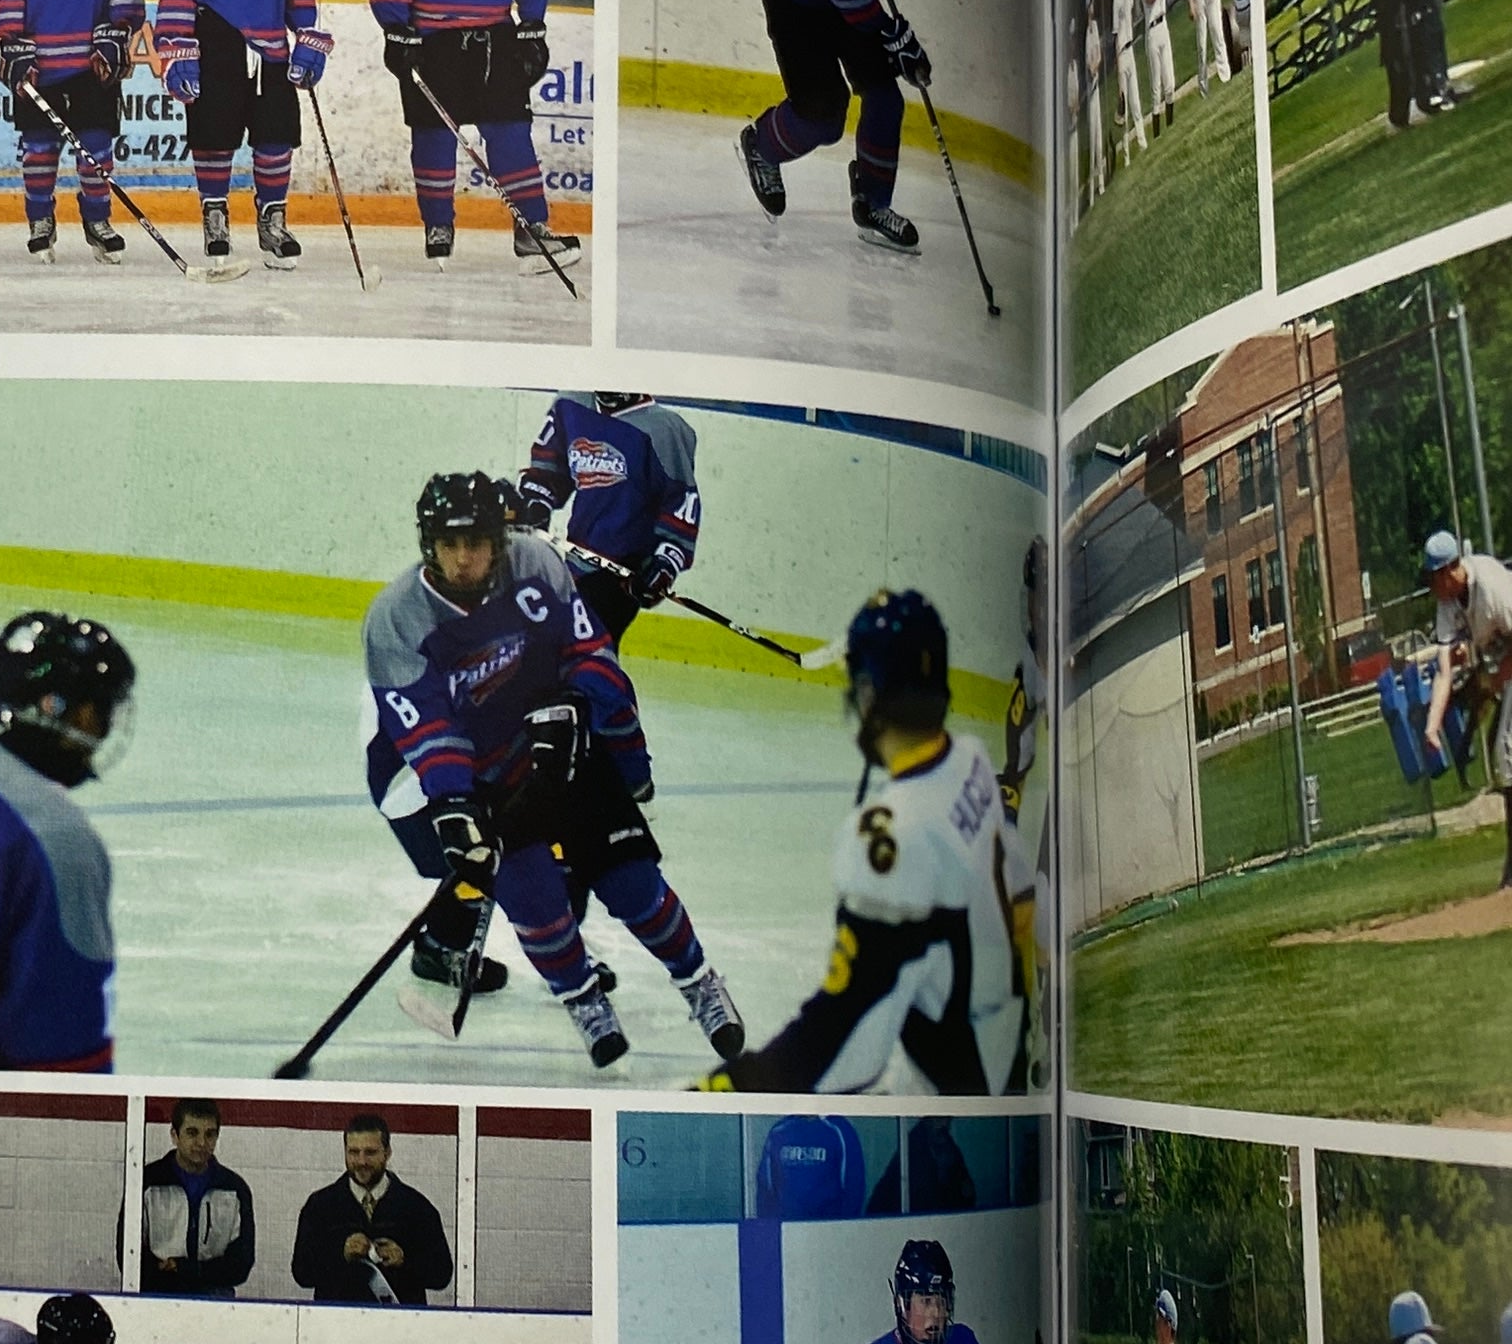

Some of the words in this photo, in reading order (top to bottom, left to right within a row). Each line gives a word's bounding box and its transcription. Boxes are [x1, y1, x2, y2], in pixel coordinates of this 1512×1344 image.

[515, 586, 549, 623] C
[572, 598, 594, 640] 8
[384, 690, 421, 730] 8
[621, 1136, 658, 1168] 6.
